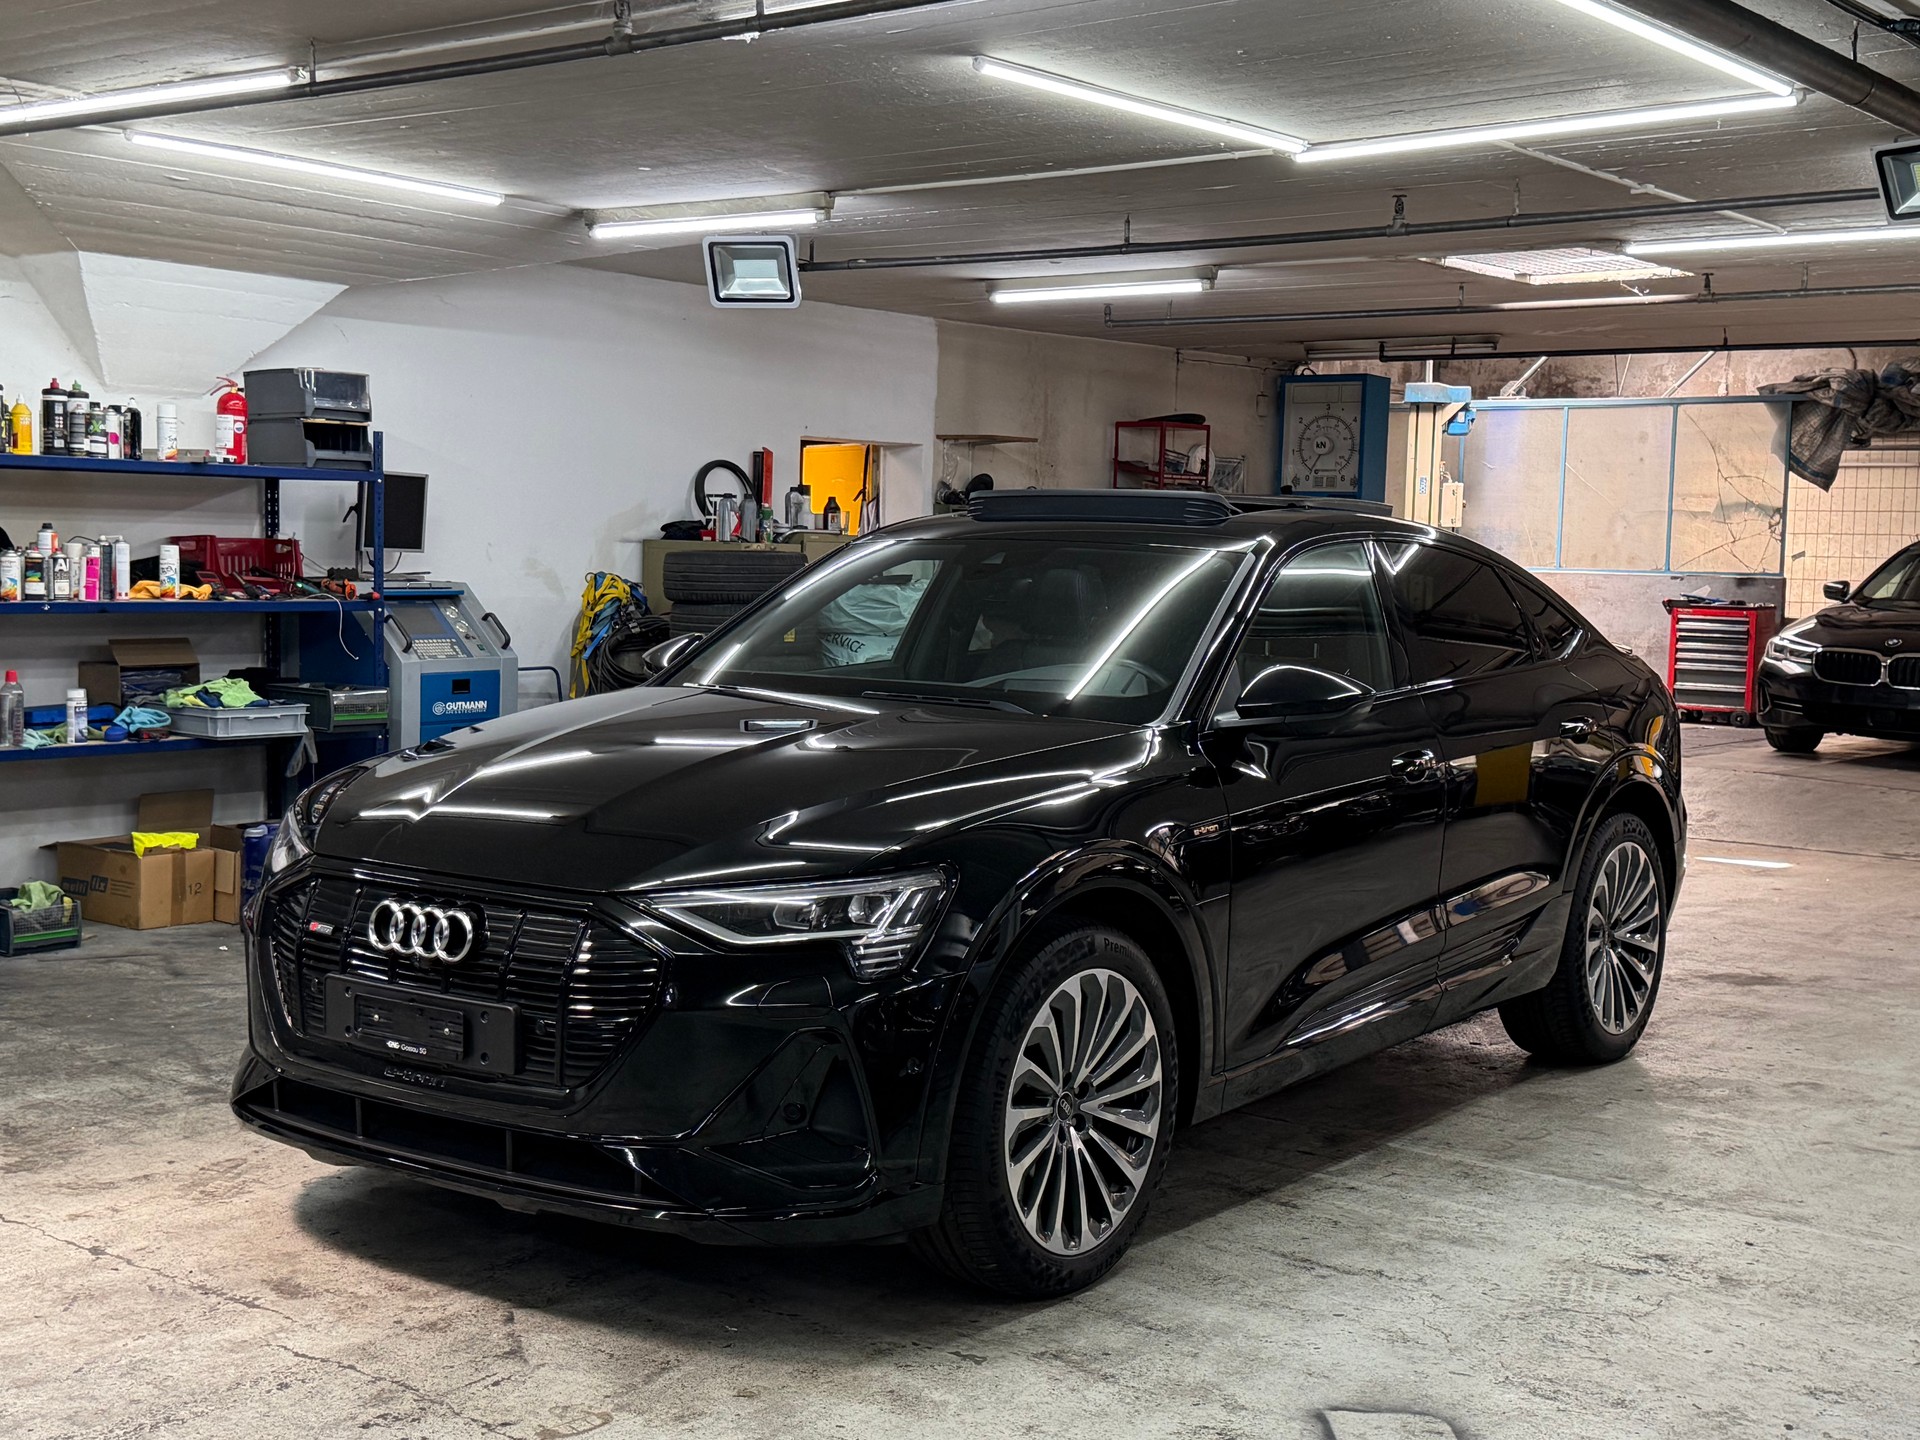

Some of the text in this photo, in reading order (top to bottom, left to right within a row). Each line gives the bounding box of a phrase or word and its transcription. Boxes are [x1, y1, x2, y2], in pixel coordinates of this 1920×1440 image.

[1315, 441, 1327, 449] kN
[445, 700, 487, 710] GUTMANN
[1193, 824, 1220, 836] e-tron
[187, 882, 203, 895] 12
